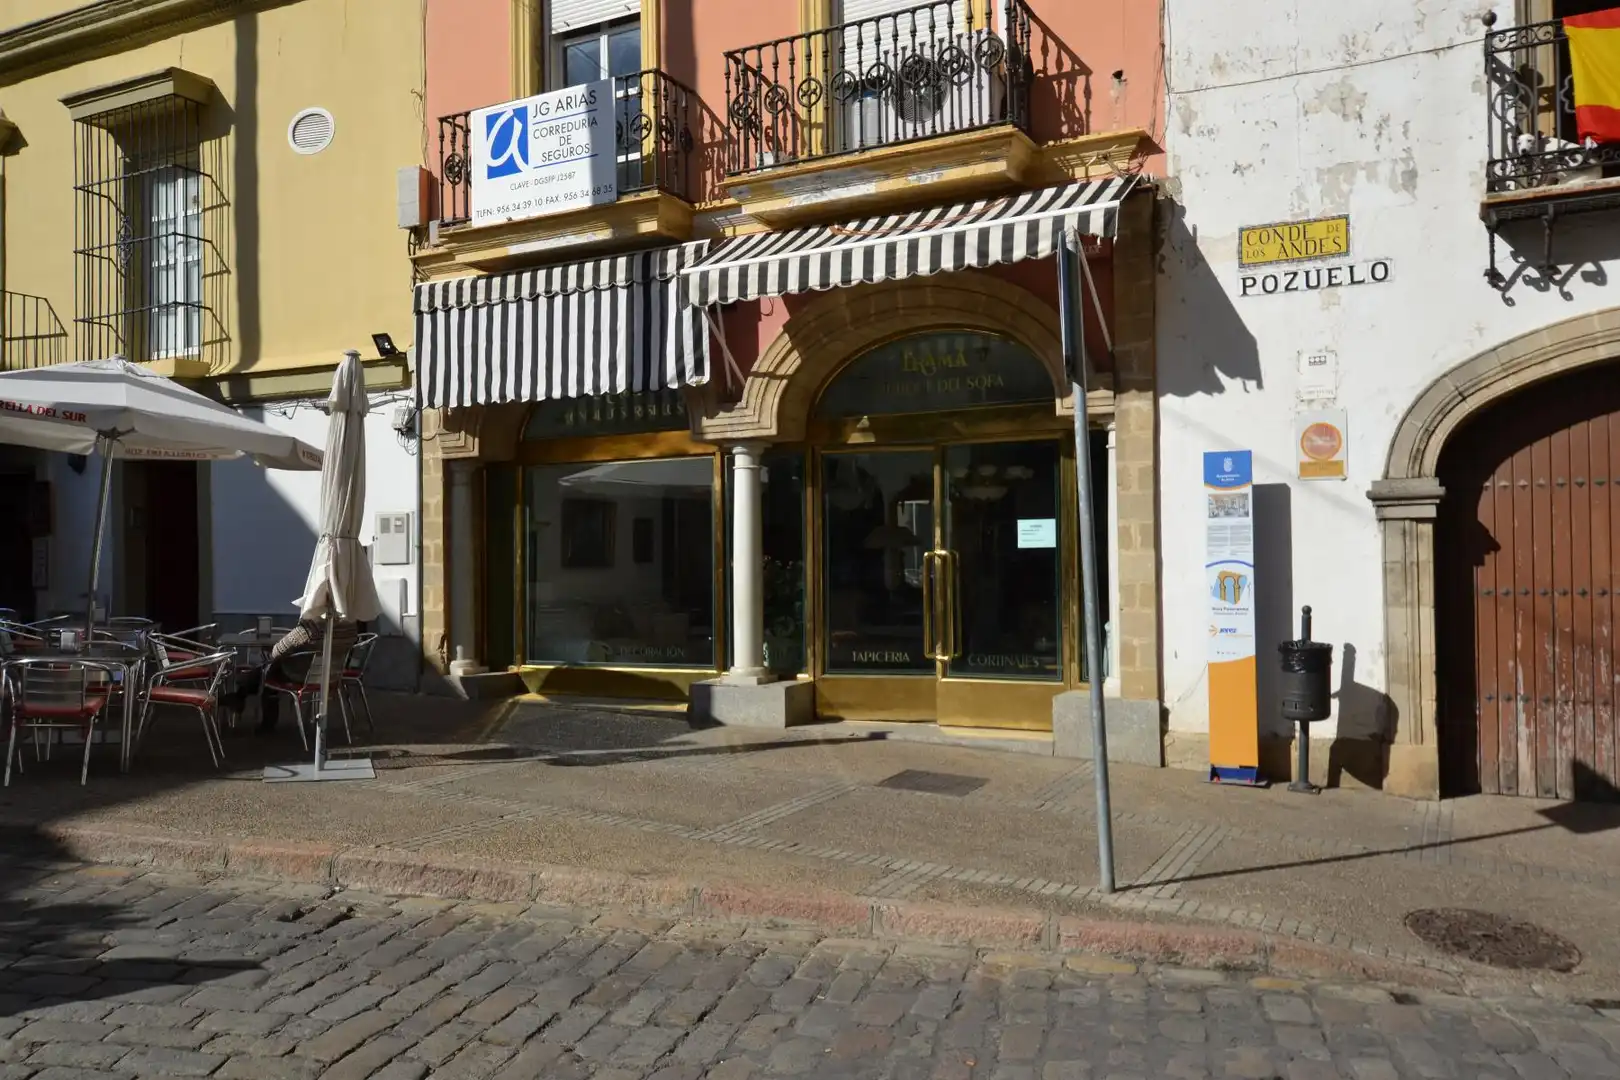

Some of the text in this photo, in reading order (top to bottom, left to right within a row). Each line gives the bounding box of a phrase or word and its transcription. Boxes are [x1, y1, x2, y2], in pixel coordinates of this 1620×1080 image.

[532, 89, 597, 118] JG ARIAS
[559, 134, 572, 147] DE
[541, 143, 590, 163] SEGUROS
[496, 204, 510, 214] 956
[511, 202, 521, 211] 34
[522, 199, 532, 209] 39
[535, 197, 543, 206] 10
[564, 192, 578, 202] 956
[603, 184, 613, 194] 35
[1246, 223, 1341, 247] CONDE DE
[1246, 236, 1342, 259] LOS ANDES
[1240, 261, 1389, 297] POZUELO
[37, 406, 60, 419] DEL
[62, 410, 87, 422] SUR
